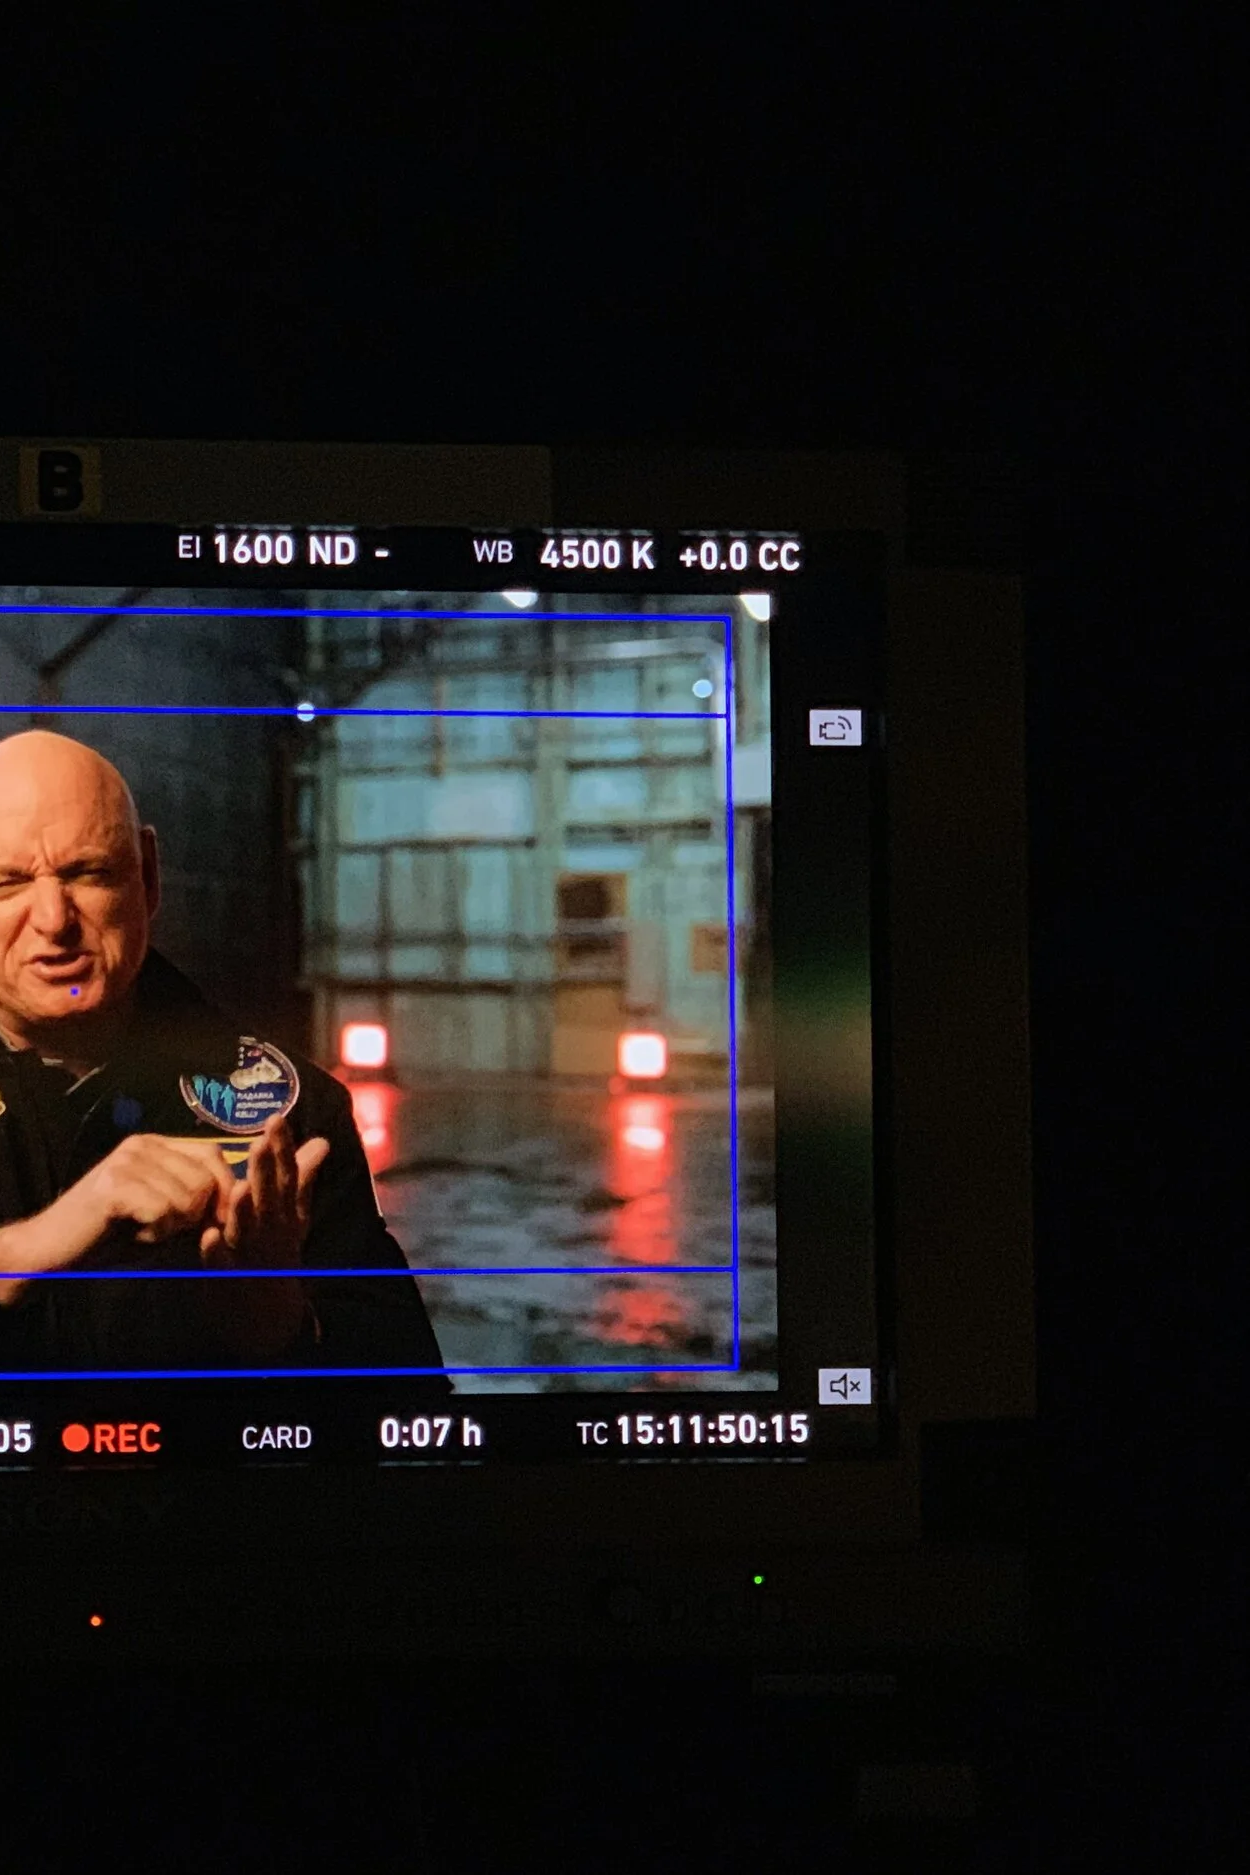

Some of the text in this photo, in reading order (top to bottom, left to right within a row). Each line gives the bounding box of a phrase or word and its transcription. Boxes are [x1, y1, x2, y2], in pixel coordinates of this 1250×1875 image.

[37, 450, 84, 512] B
[178, 535, 201, 559] EI
[214, 535, 295, 565] 1600
[308, 536, 357, 566] ND
[472, 539, 801, 572] WB 4500 K +0.0 CC
[94, 1423, 161, 1454] REC
[242, 1426, 312, 1450] CARD
[380, 1417, 482, 1448] 0:07 h
[576, 1413, 809, 1445] TC 15:11:50:15
